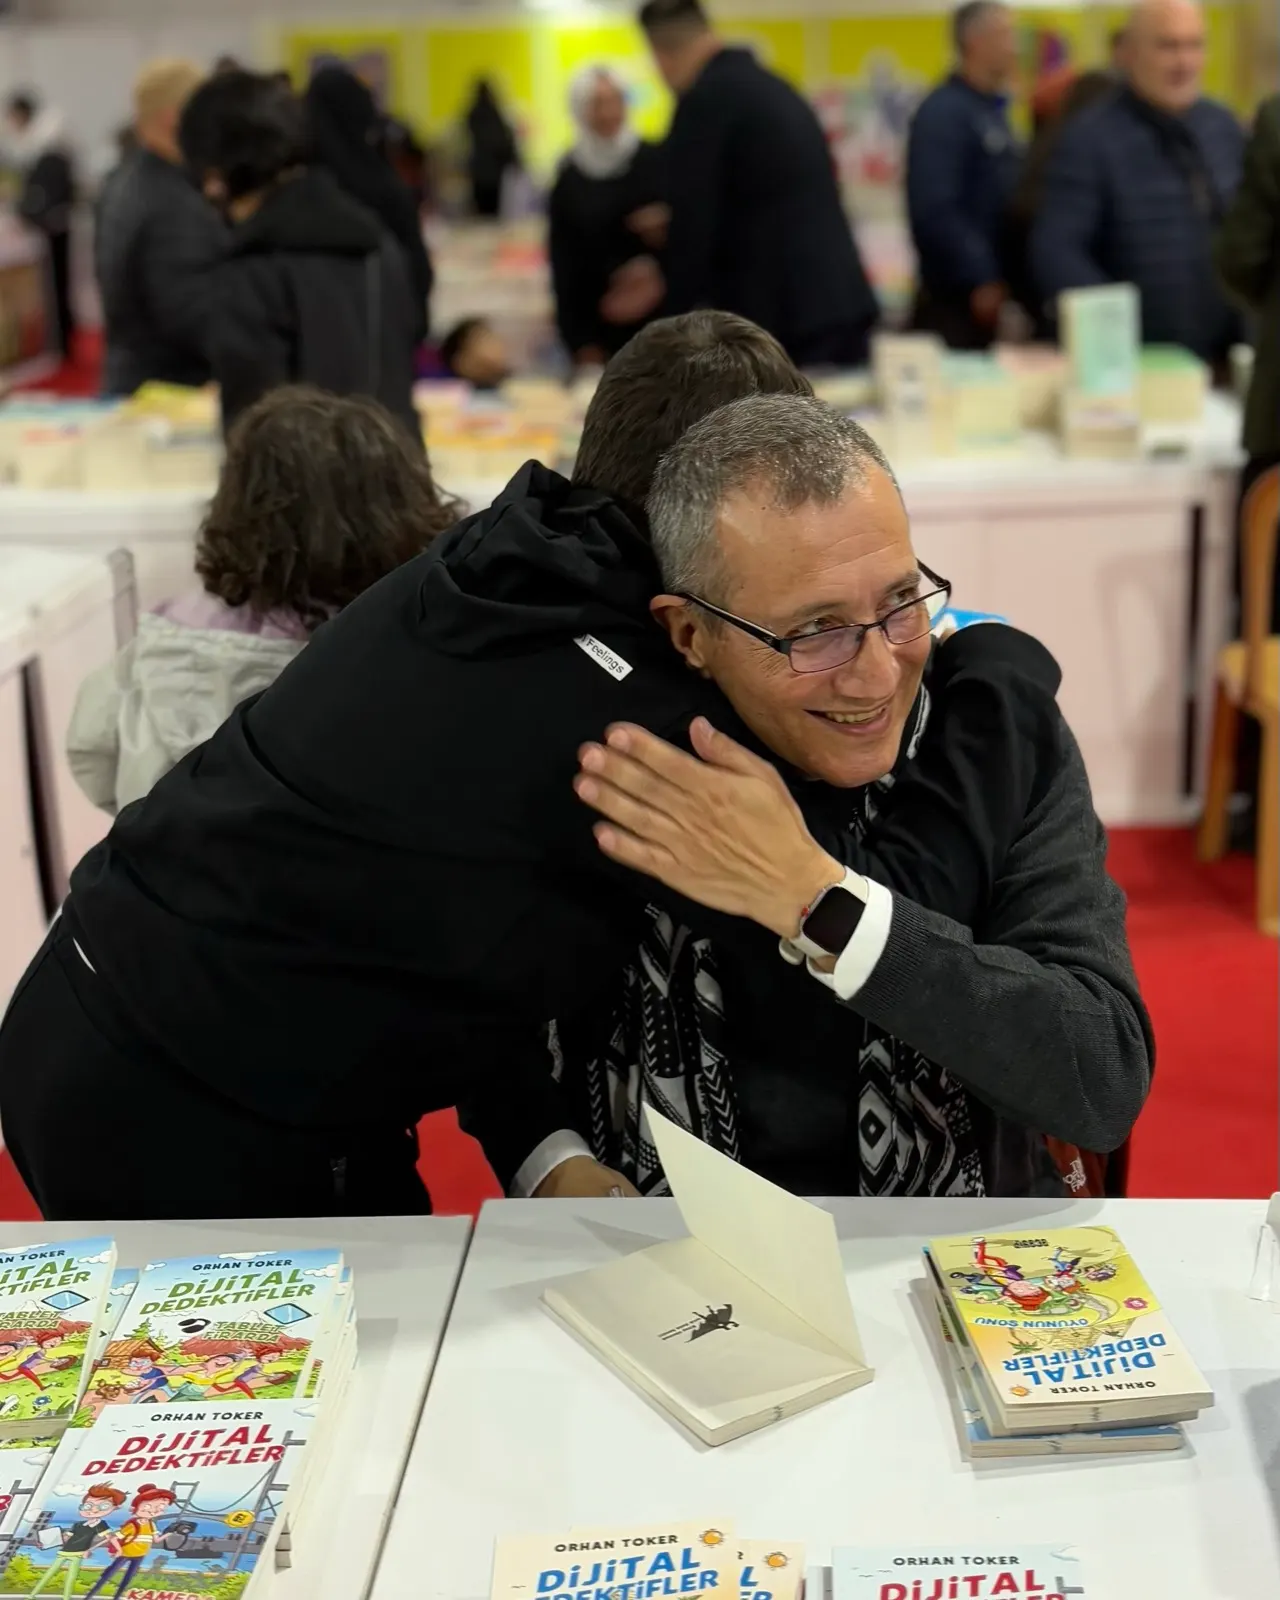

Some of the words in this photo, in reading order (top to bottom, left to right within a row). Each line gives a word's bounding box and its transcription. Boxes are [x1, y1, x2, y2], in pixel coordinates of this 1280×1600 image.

[586, 638, 625, 674] Feelings
[20, 1249, 66, 1261] TOKER
[192, 1261, 242, 1271] ORHAN
[247, 1259, 293, 1268] TOKER
[0, 1320, 59, 1329] RARDA
[974, 1317, 1019, 1327] SONU
[1023, 1318, 1088, 1328] OYUNUN
[1050, 1384, 1099, 1395] TOKER
[1104, 1381, 1156, 1392] ORHAN
[151, 1412, 205, 1422] ORHAN
[212, 1411, 263, 1421] TOKER
[555, 1540, 615, 1553] ORHAN
[622, 1534, 679, 1549] TOKER
[893, 1556, 954, 1566] ORHAN
[961, 1556, 1020, 1565] TOKER
